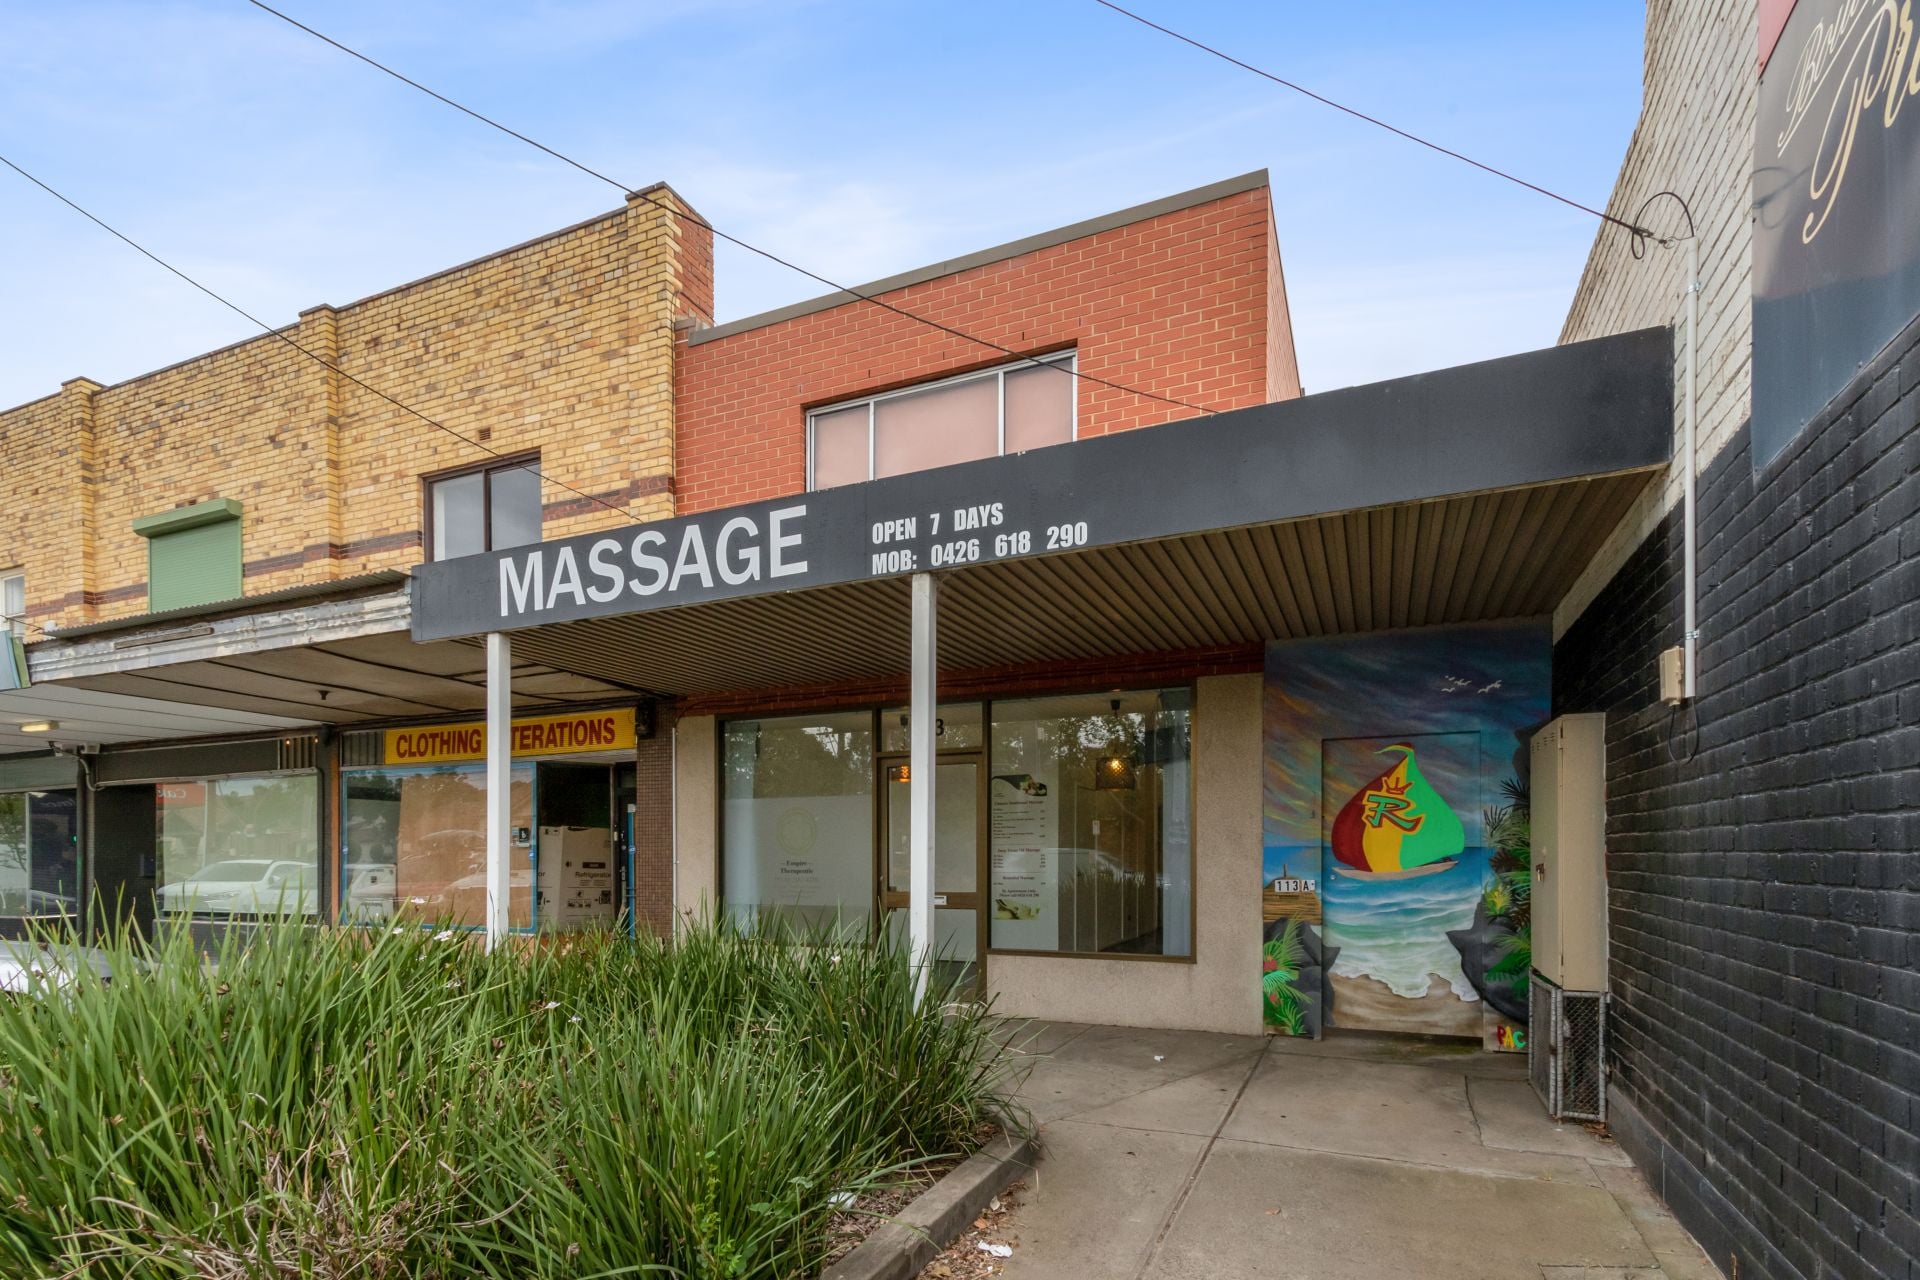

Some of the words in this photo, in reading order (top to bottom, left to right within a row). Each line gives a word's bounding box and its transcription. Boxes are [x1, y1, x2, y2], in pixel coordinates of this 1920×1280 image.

[872, 517, 917, 544] OPEN
[930, 513, 940, 535] 7
[954, 502, 1003, 531] DAYS
[500, 504, 808, 616] MASSAGE
[872, 549, 917, 575] MOB:
[931, 539, 980, 567] 0426
[995, 531, 1031, 557] 618
[1046, 522, 1088, 550] 290
[396, 729, 482, 758] CLOTHING
[511, 717, 615, 750] TERATIONS
[1497, 1025, 1526, 1048] PAC
